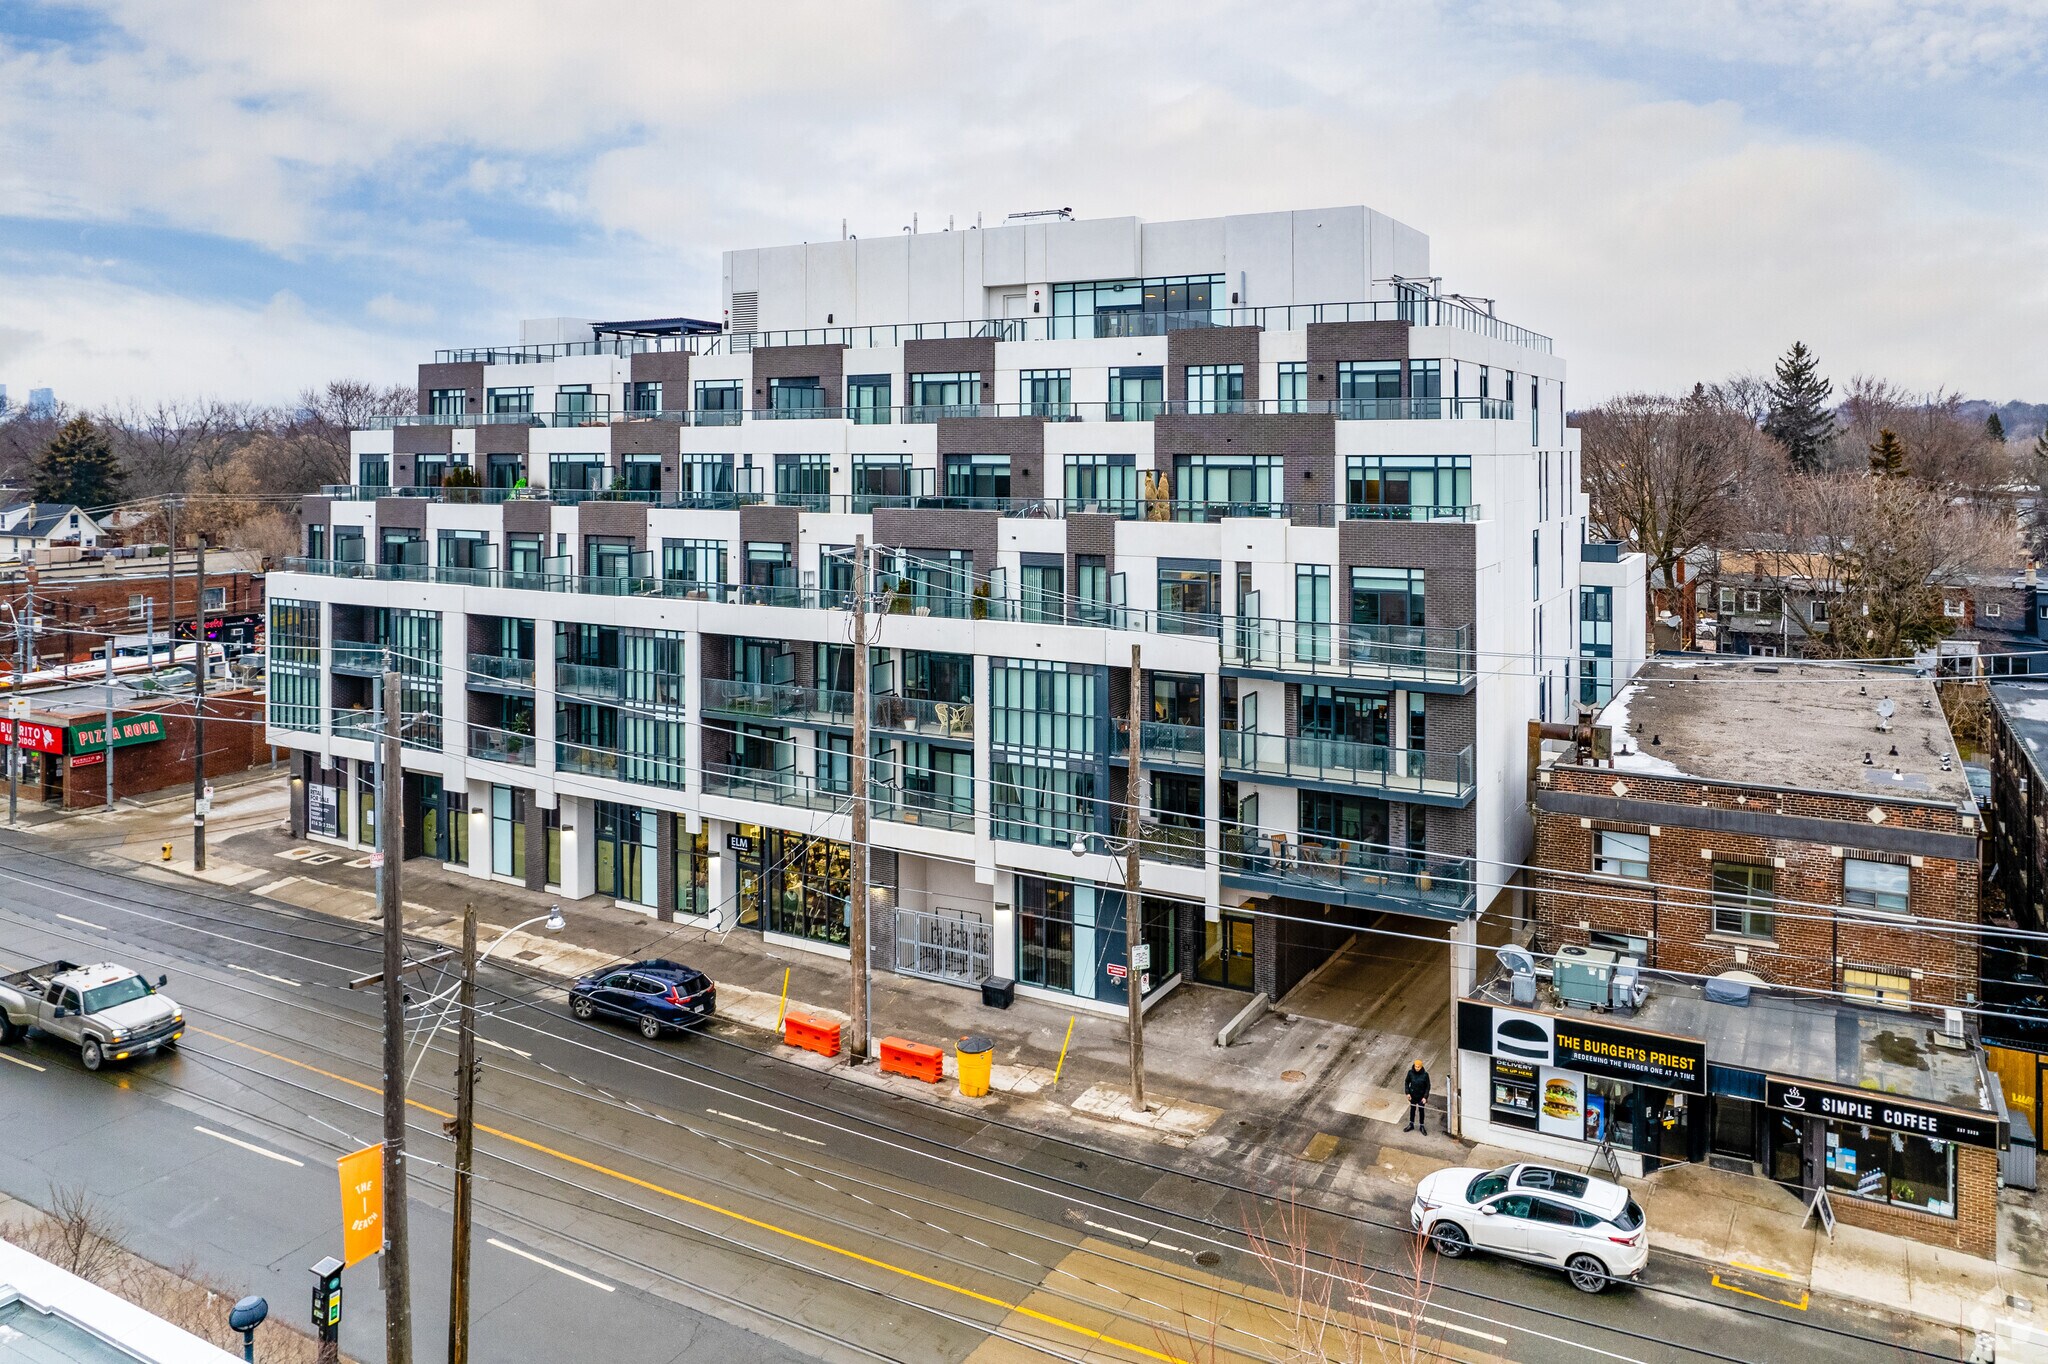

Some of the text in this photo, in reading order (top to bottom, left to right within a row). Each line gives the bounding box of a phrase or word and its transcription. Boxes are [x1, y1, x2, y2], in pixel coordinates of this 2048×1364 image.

[0, 722, 41, 739] BURITO
[123, 720, 159, 738] NOVA
[5, 734, 36, 746] BADIDOS
[731, 837, 748, 848] ELM
[1556, 1034, 1696, 1071] THE BURGER'S PRIEST
[1497, 1061, 1533, 1070] DELIVERY
[1573, 1052, 1608, 1065] REDEEMING
[1610, 1059, 1622, 1068] THE
[1623, 1062, 1649, 1073] BURGER
[1650, 1067, 1663, 1075] ONE
[1680, 1072, 1696, 1081] TIME
[1822, 1097, 1938, 1132] SIMPLE COFFEE
[355, 1180, 373, 1195] THE
[351, 1211, 379, 1231] BEACH
